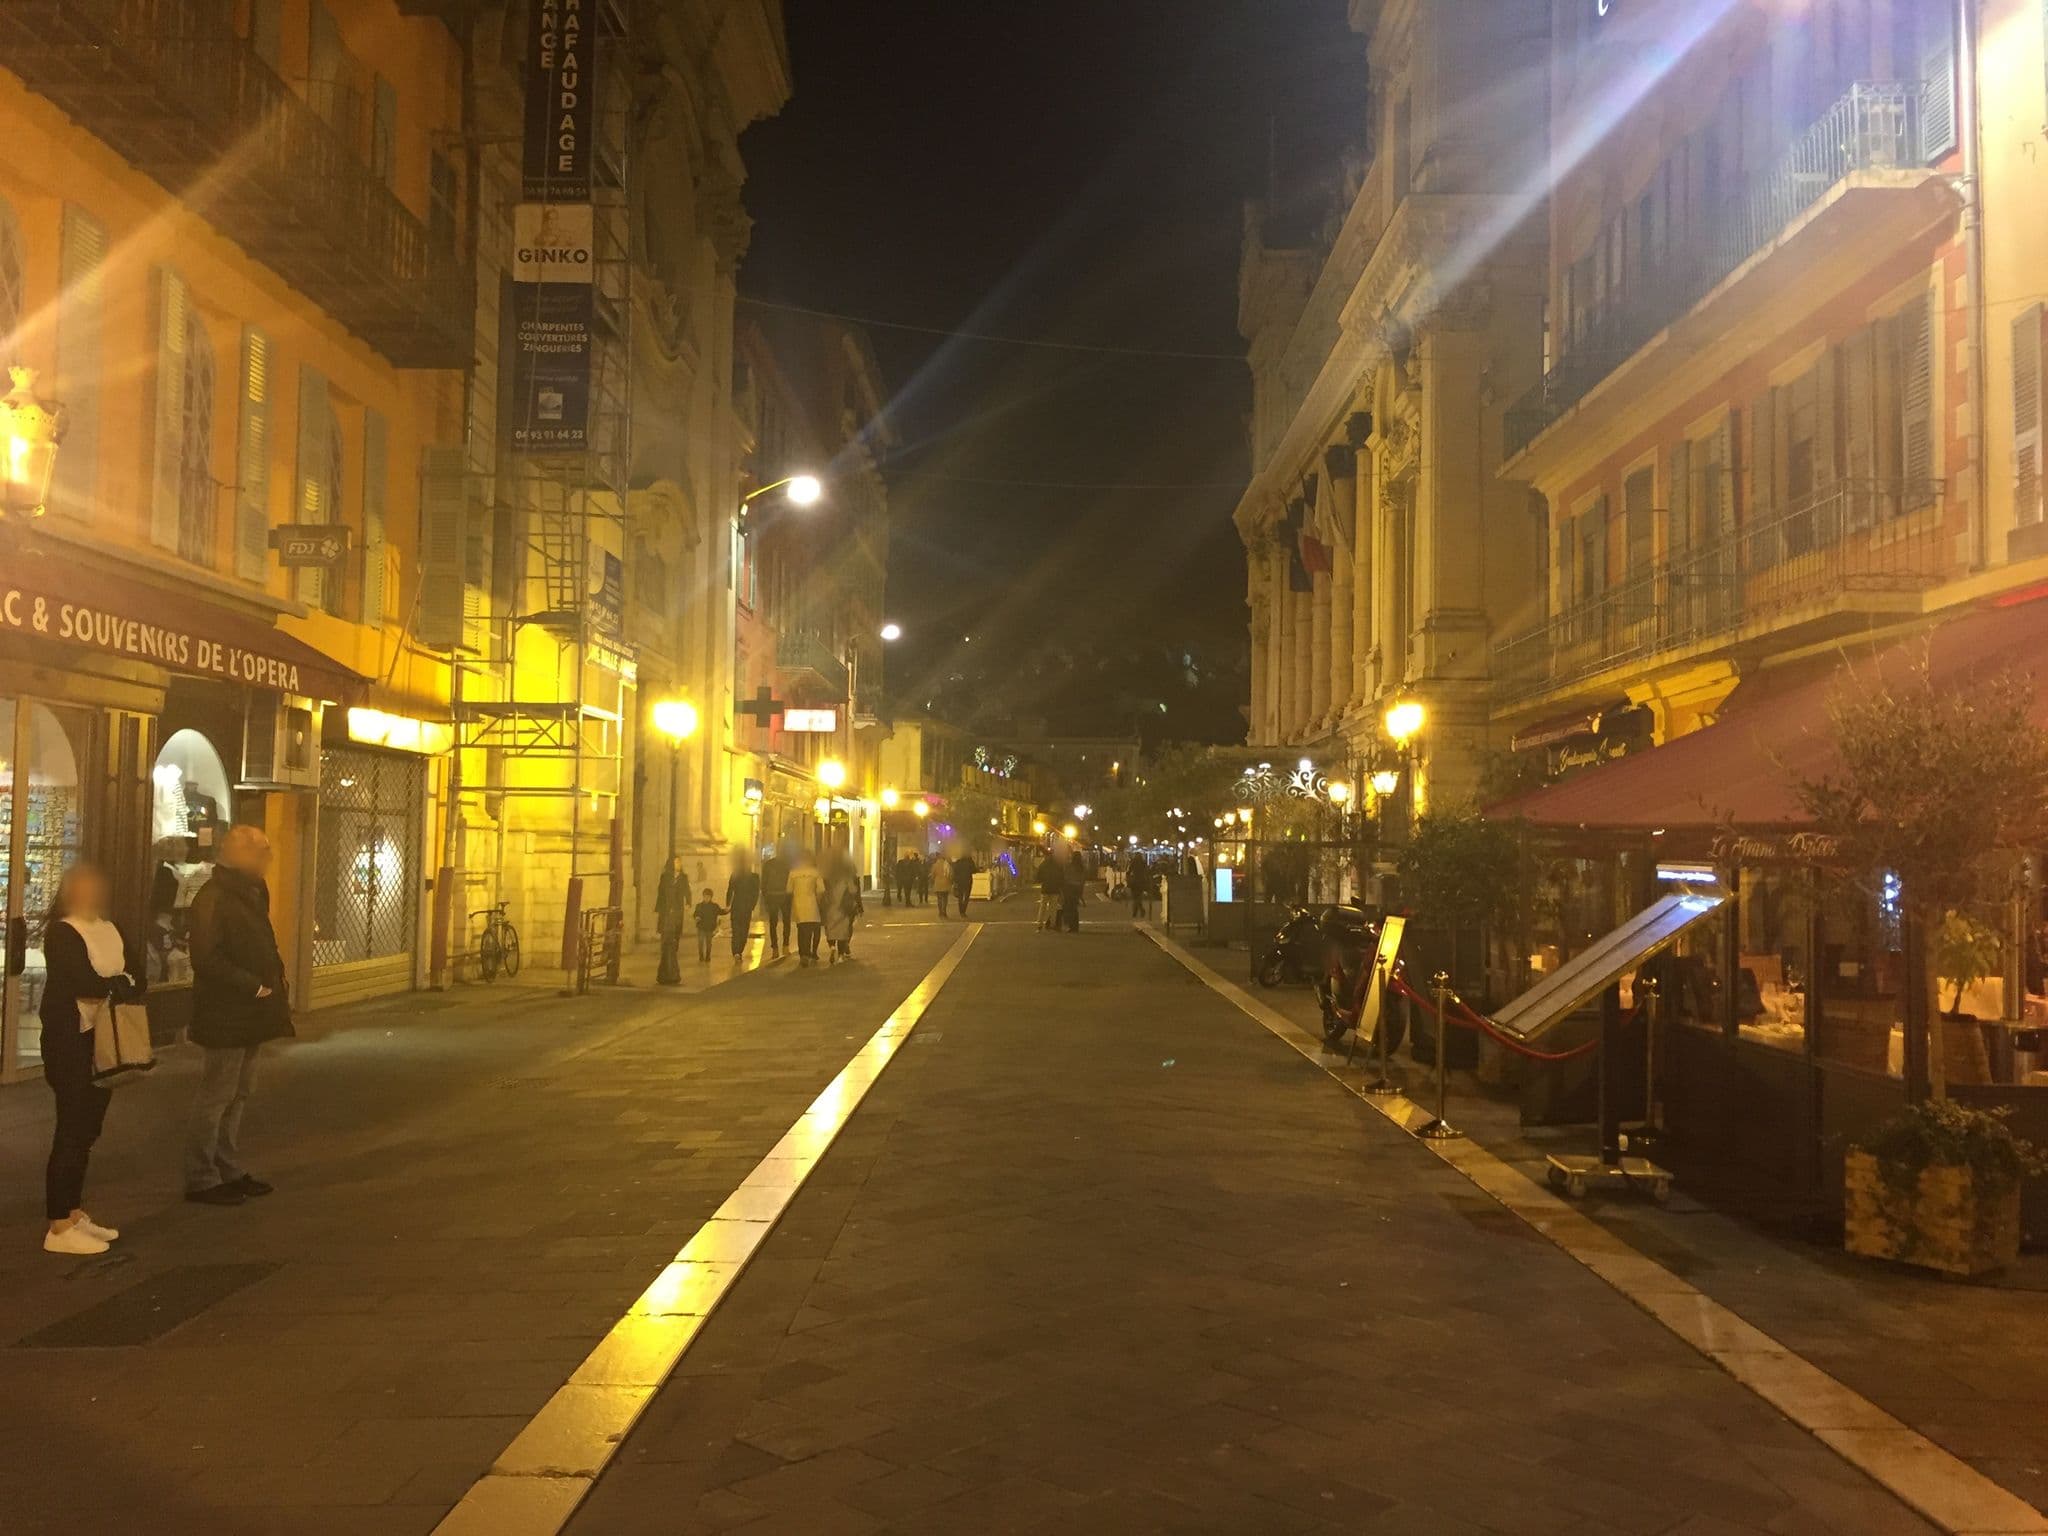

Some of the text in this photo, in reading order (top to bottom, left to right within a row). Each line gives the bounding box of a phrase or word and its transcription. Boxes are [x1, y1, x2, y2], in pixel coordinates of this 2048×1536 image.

[521, 321, 585, 332] CHARPENTES
[518, 332, 588, 343] COUVERTURES
[288, 542, 316, 555] FDJ
[32, 595, 50, 633] &
[59, 603, 190, 665] SOUVENIRS
[197, 639, 225, 672] DE
[229, 648, 301, 692] L'OPERA
